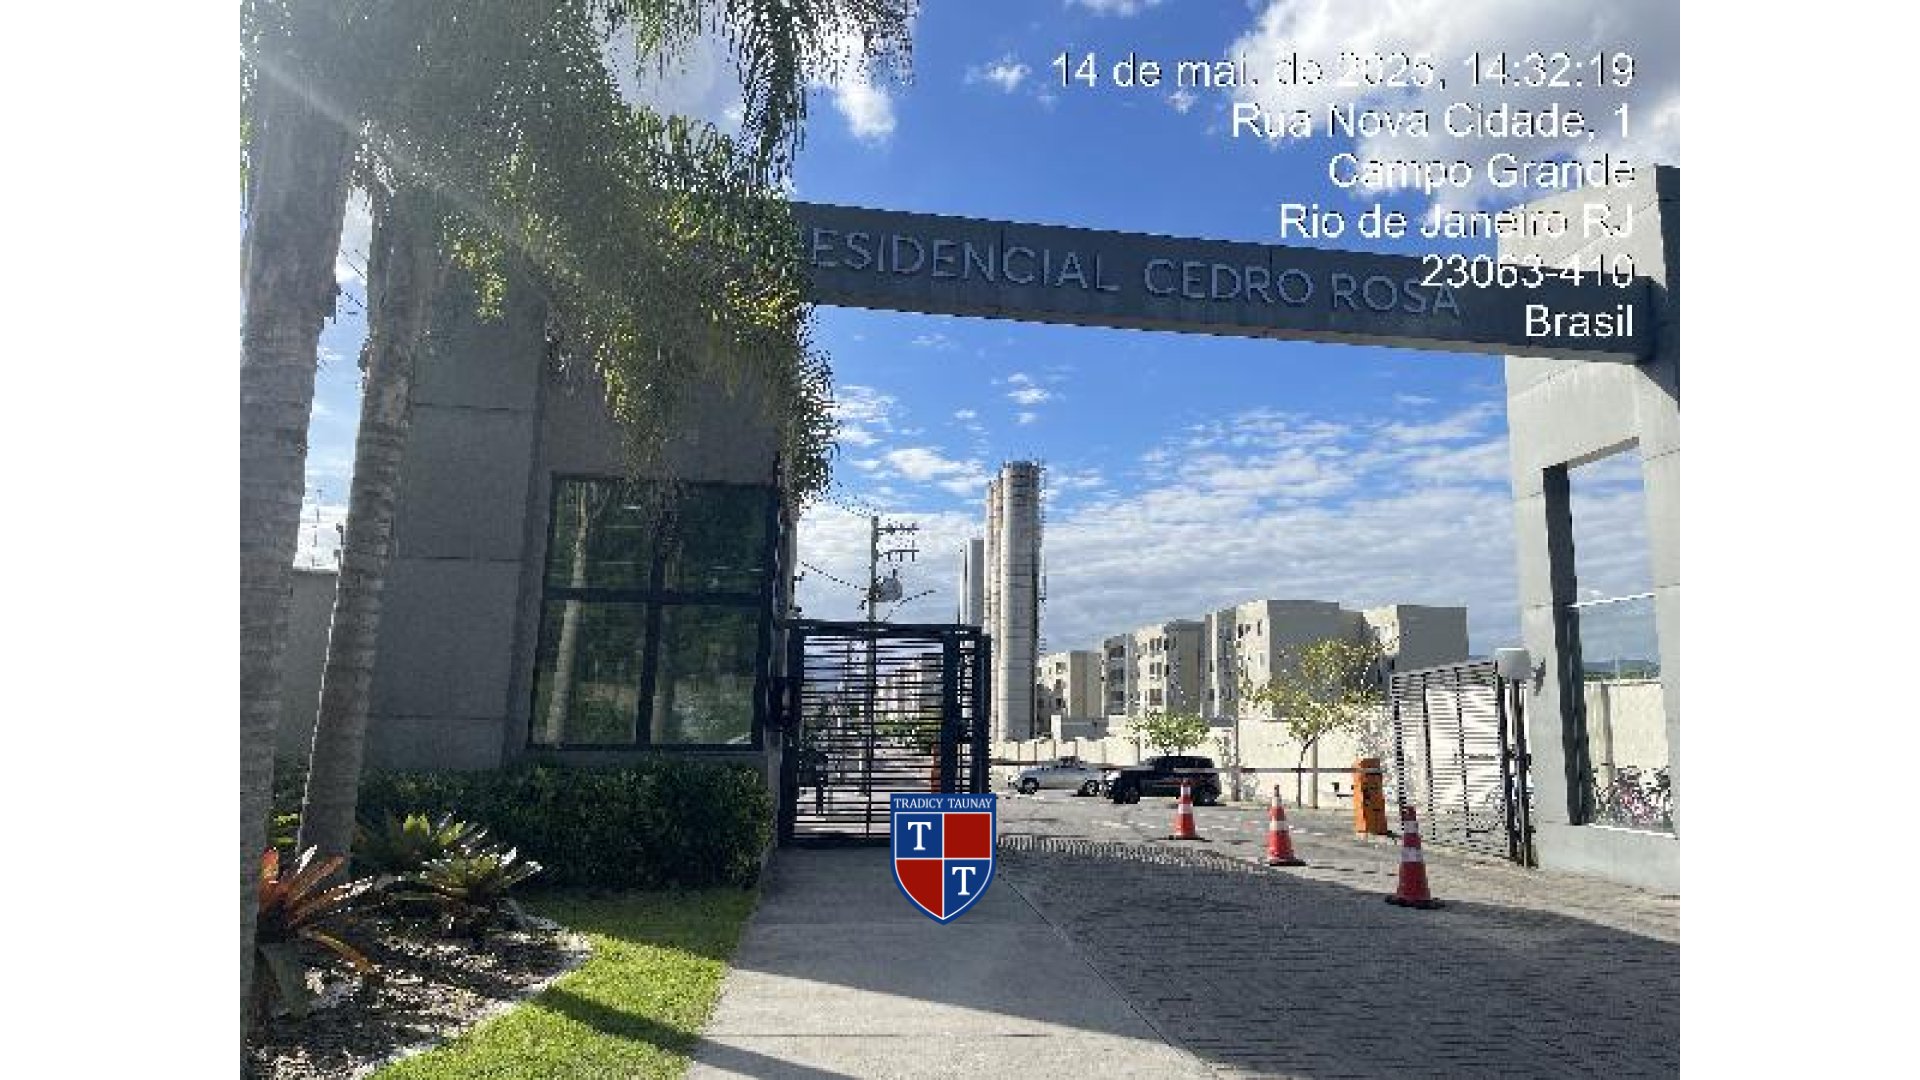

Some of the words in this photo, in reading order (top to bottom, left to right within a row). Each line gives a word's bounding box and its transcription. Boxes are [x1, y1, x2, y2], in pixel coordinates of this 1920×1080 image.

[807, 227, 1120, 291] ESIDENCIAL
[1144, 258, 1315, 304] CEDRO
[1331, 272, 1460, 317] ROSA
